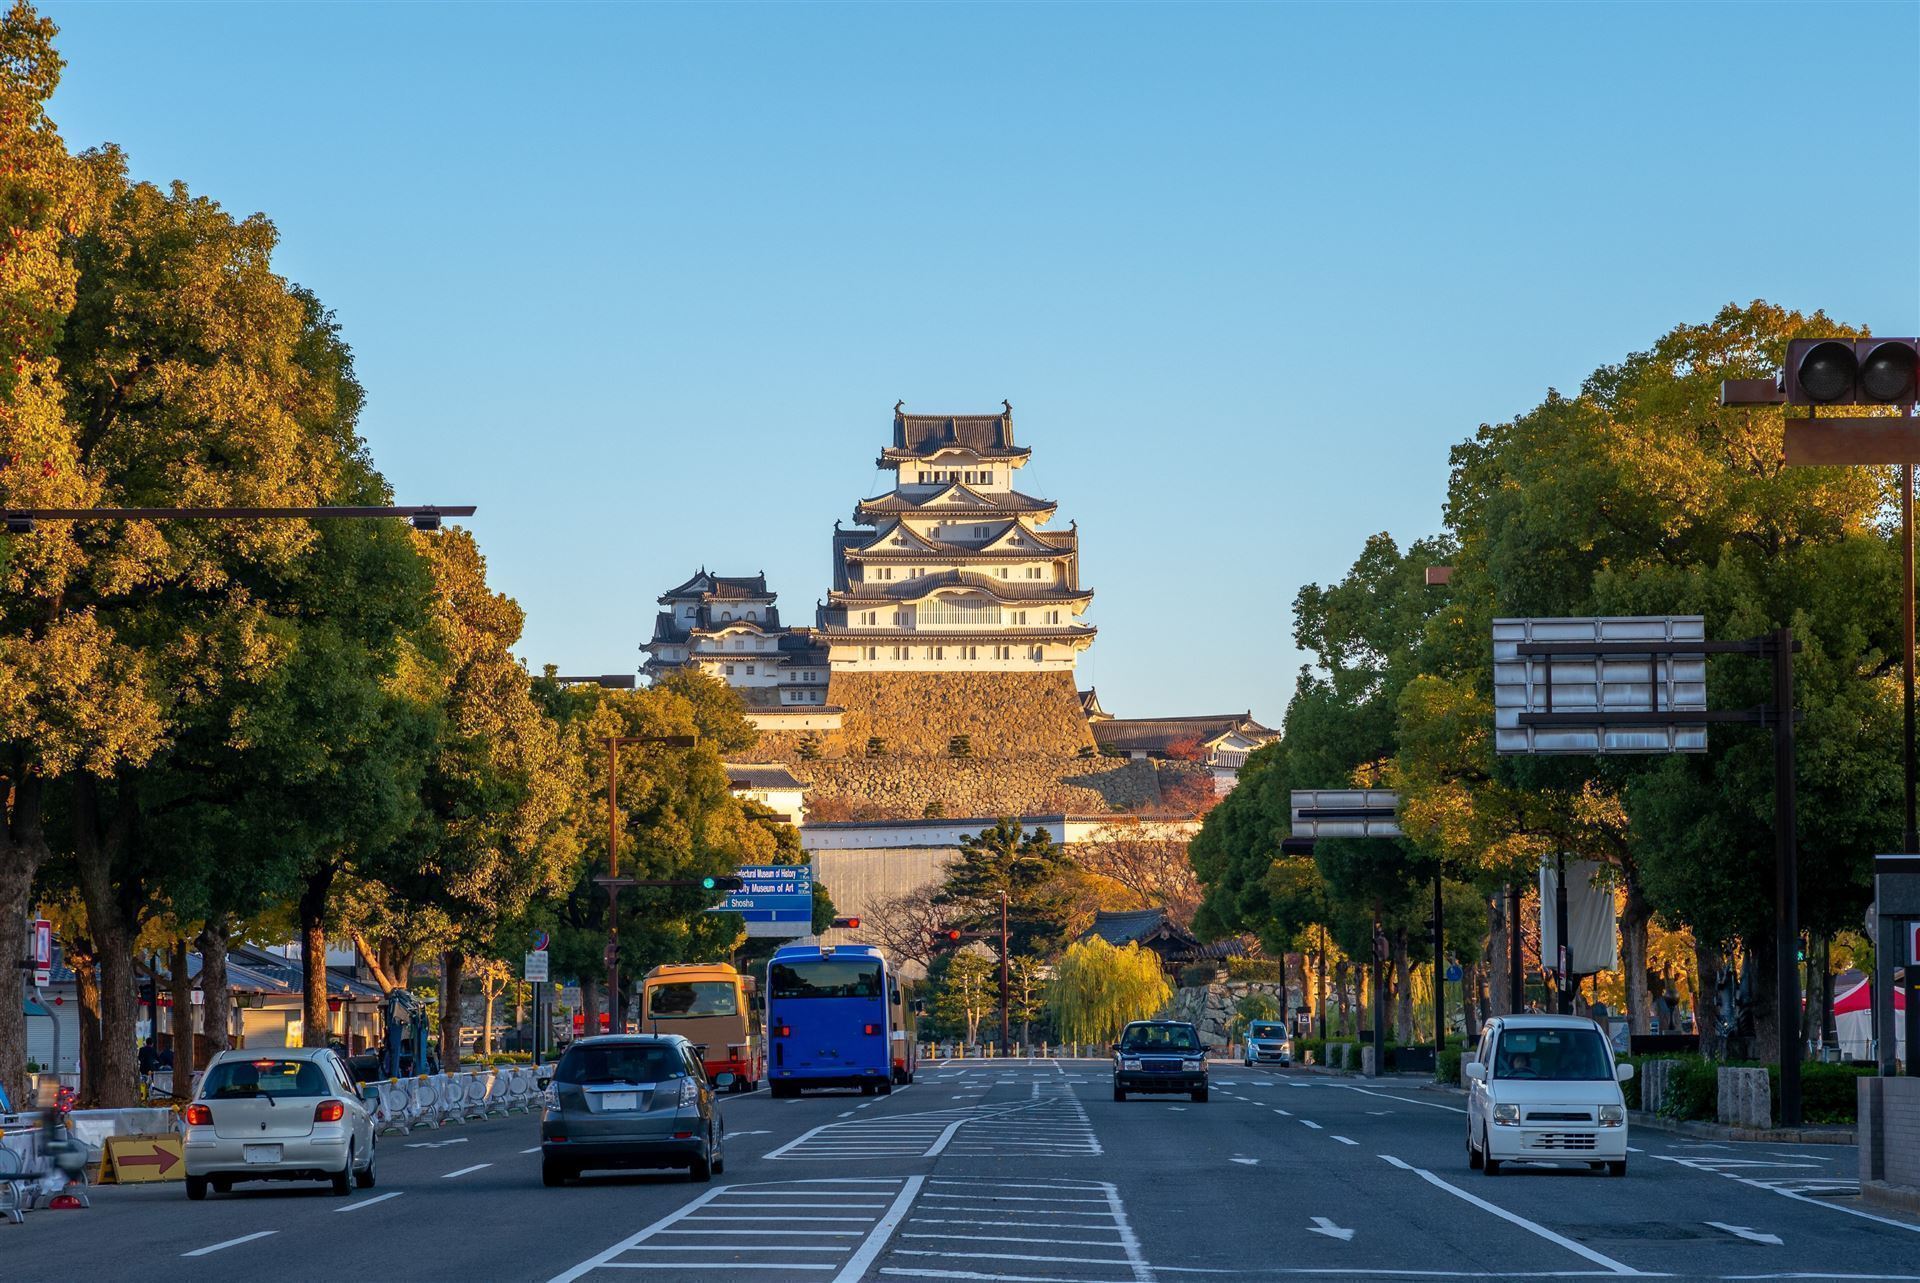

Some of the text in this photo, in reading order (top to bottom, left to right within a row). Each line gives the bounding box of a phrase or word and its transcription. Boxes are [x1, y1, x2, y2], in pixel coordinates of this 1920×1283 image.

[757, 869, 774, 878] Museum
[775, 869, 780, 878] of
[781, 869, 796, 879] History
[751, 884, 775, 893] Museum
[777, 884, 783, 892] of
[785, 884, 794, 893] Art
[731, 898, 754, 908] Shosha
